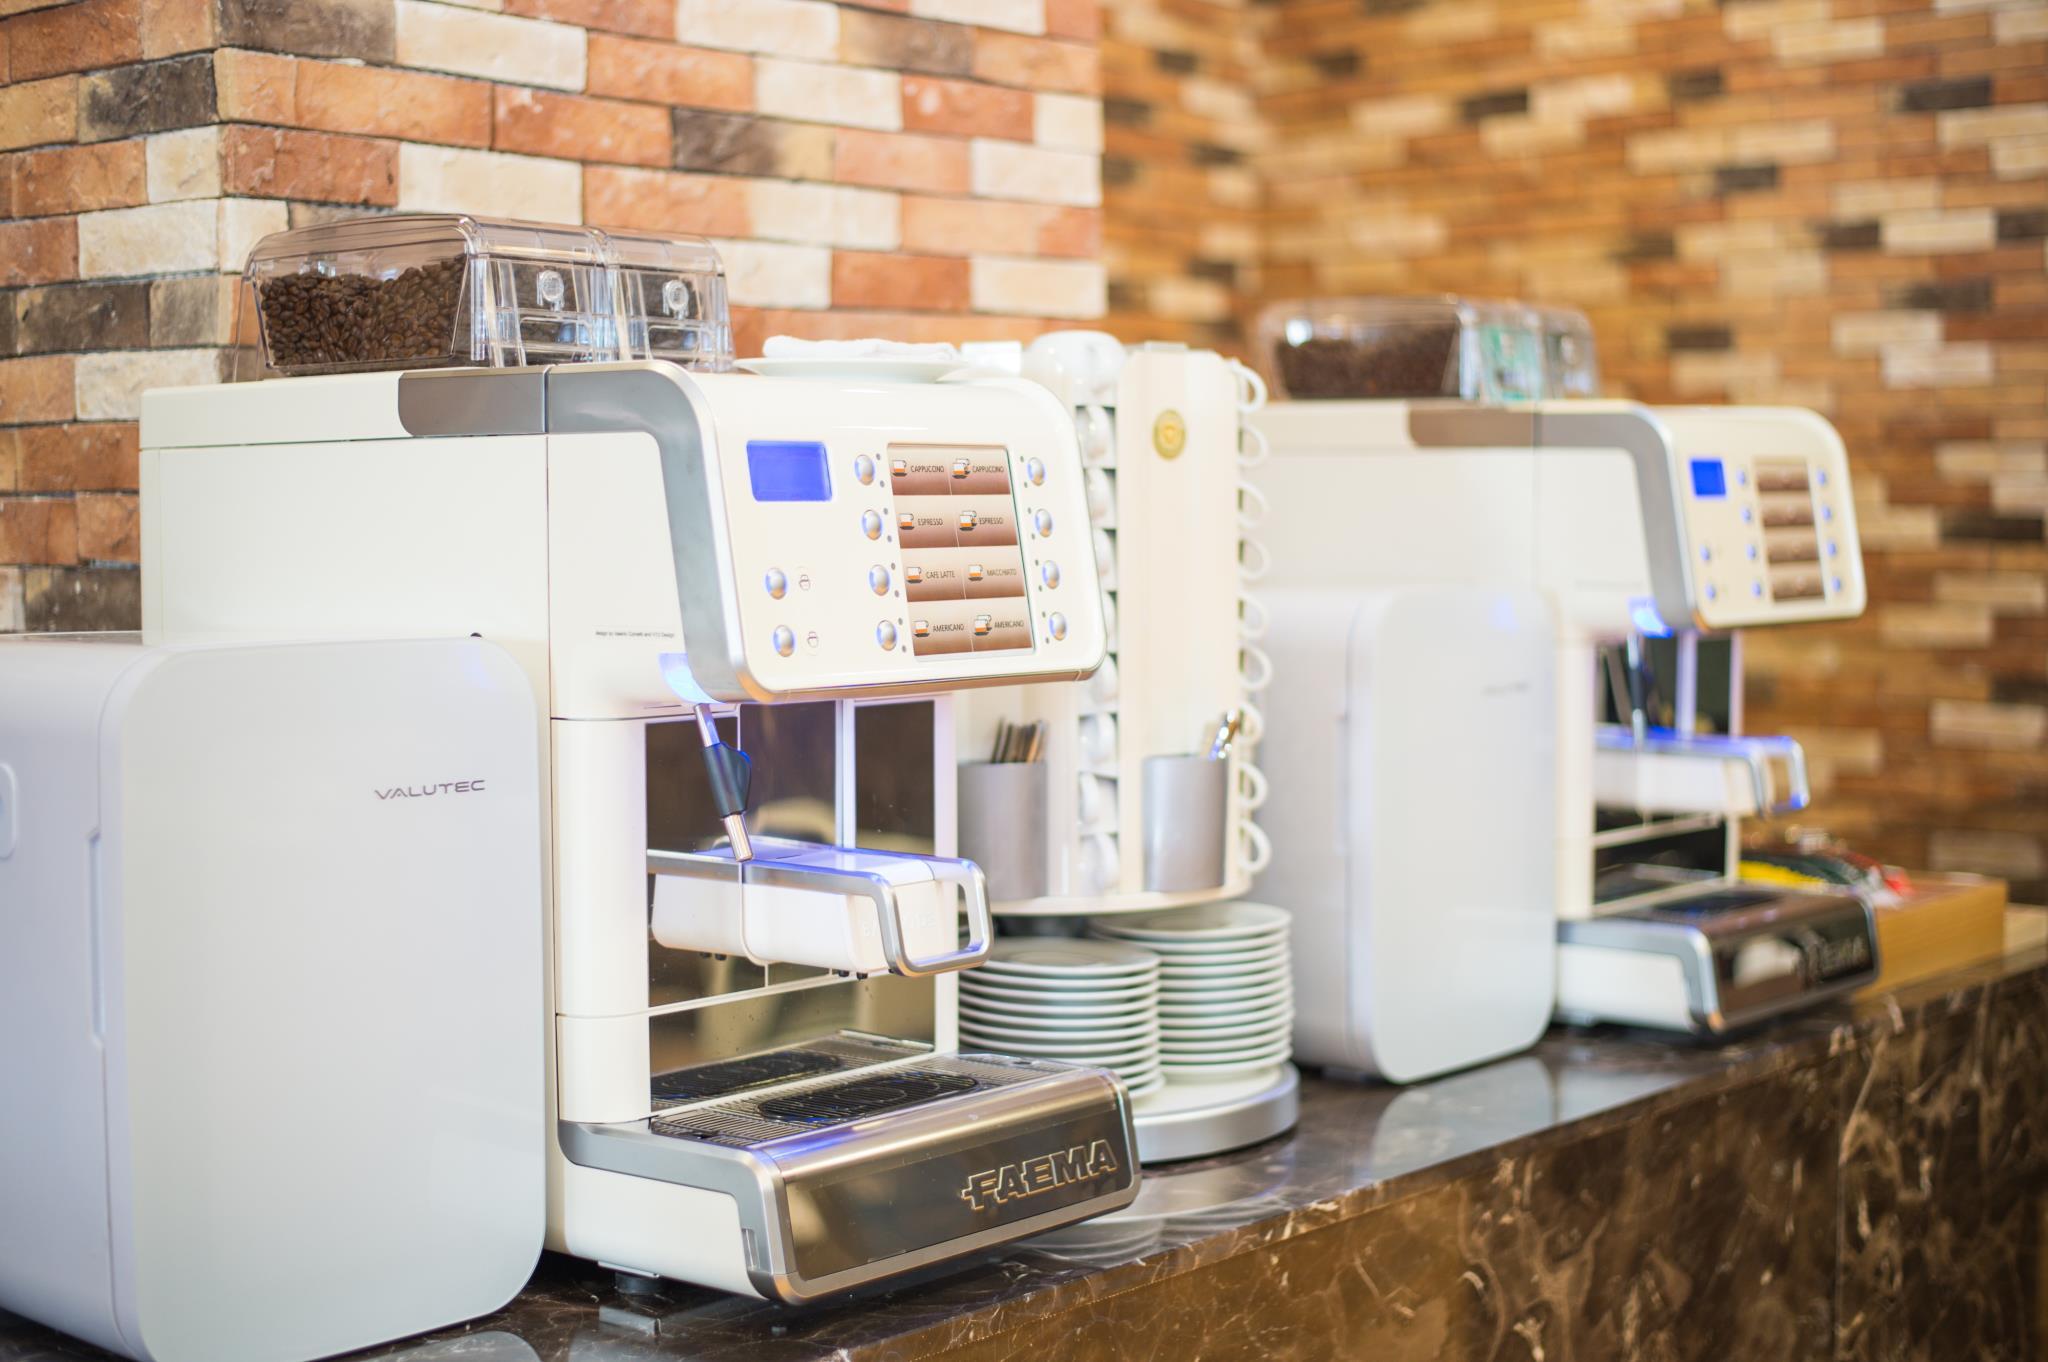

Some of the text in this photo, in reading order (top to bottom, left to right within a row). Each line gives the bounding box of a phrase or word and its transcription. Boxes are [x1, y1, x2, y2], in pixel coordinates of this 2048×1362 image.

[910, 465, 945, 473] CAPPUCCINO
[971, 465, 1005, 473] CAPPUCCINO
[917, 518, 944, 526] ESPRESSO
[978, 517, 1004, 525] ESPRESSO
[940, 570, 956, 578] LATTE
[932, 623, 965, 633] AMERICANO
[993, 620, 1025, 629] AMERICANO
[374, 779, 486, 800] VALUTEC
[961, 1139, 1119, 1211] FAEMA
